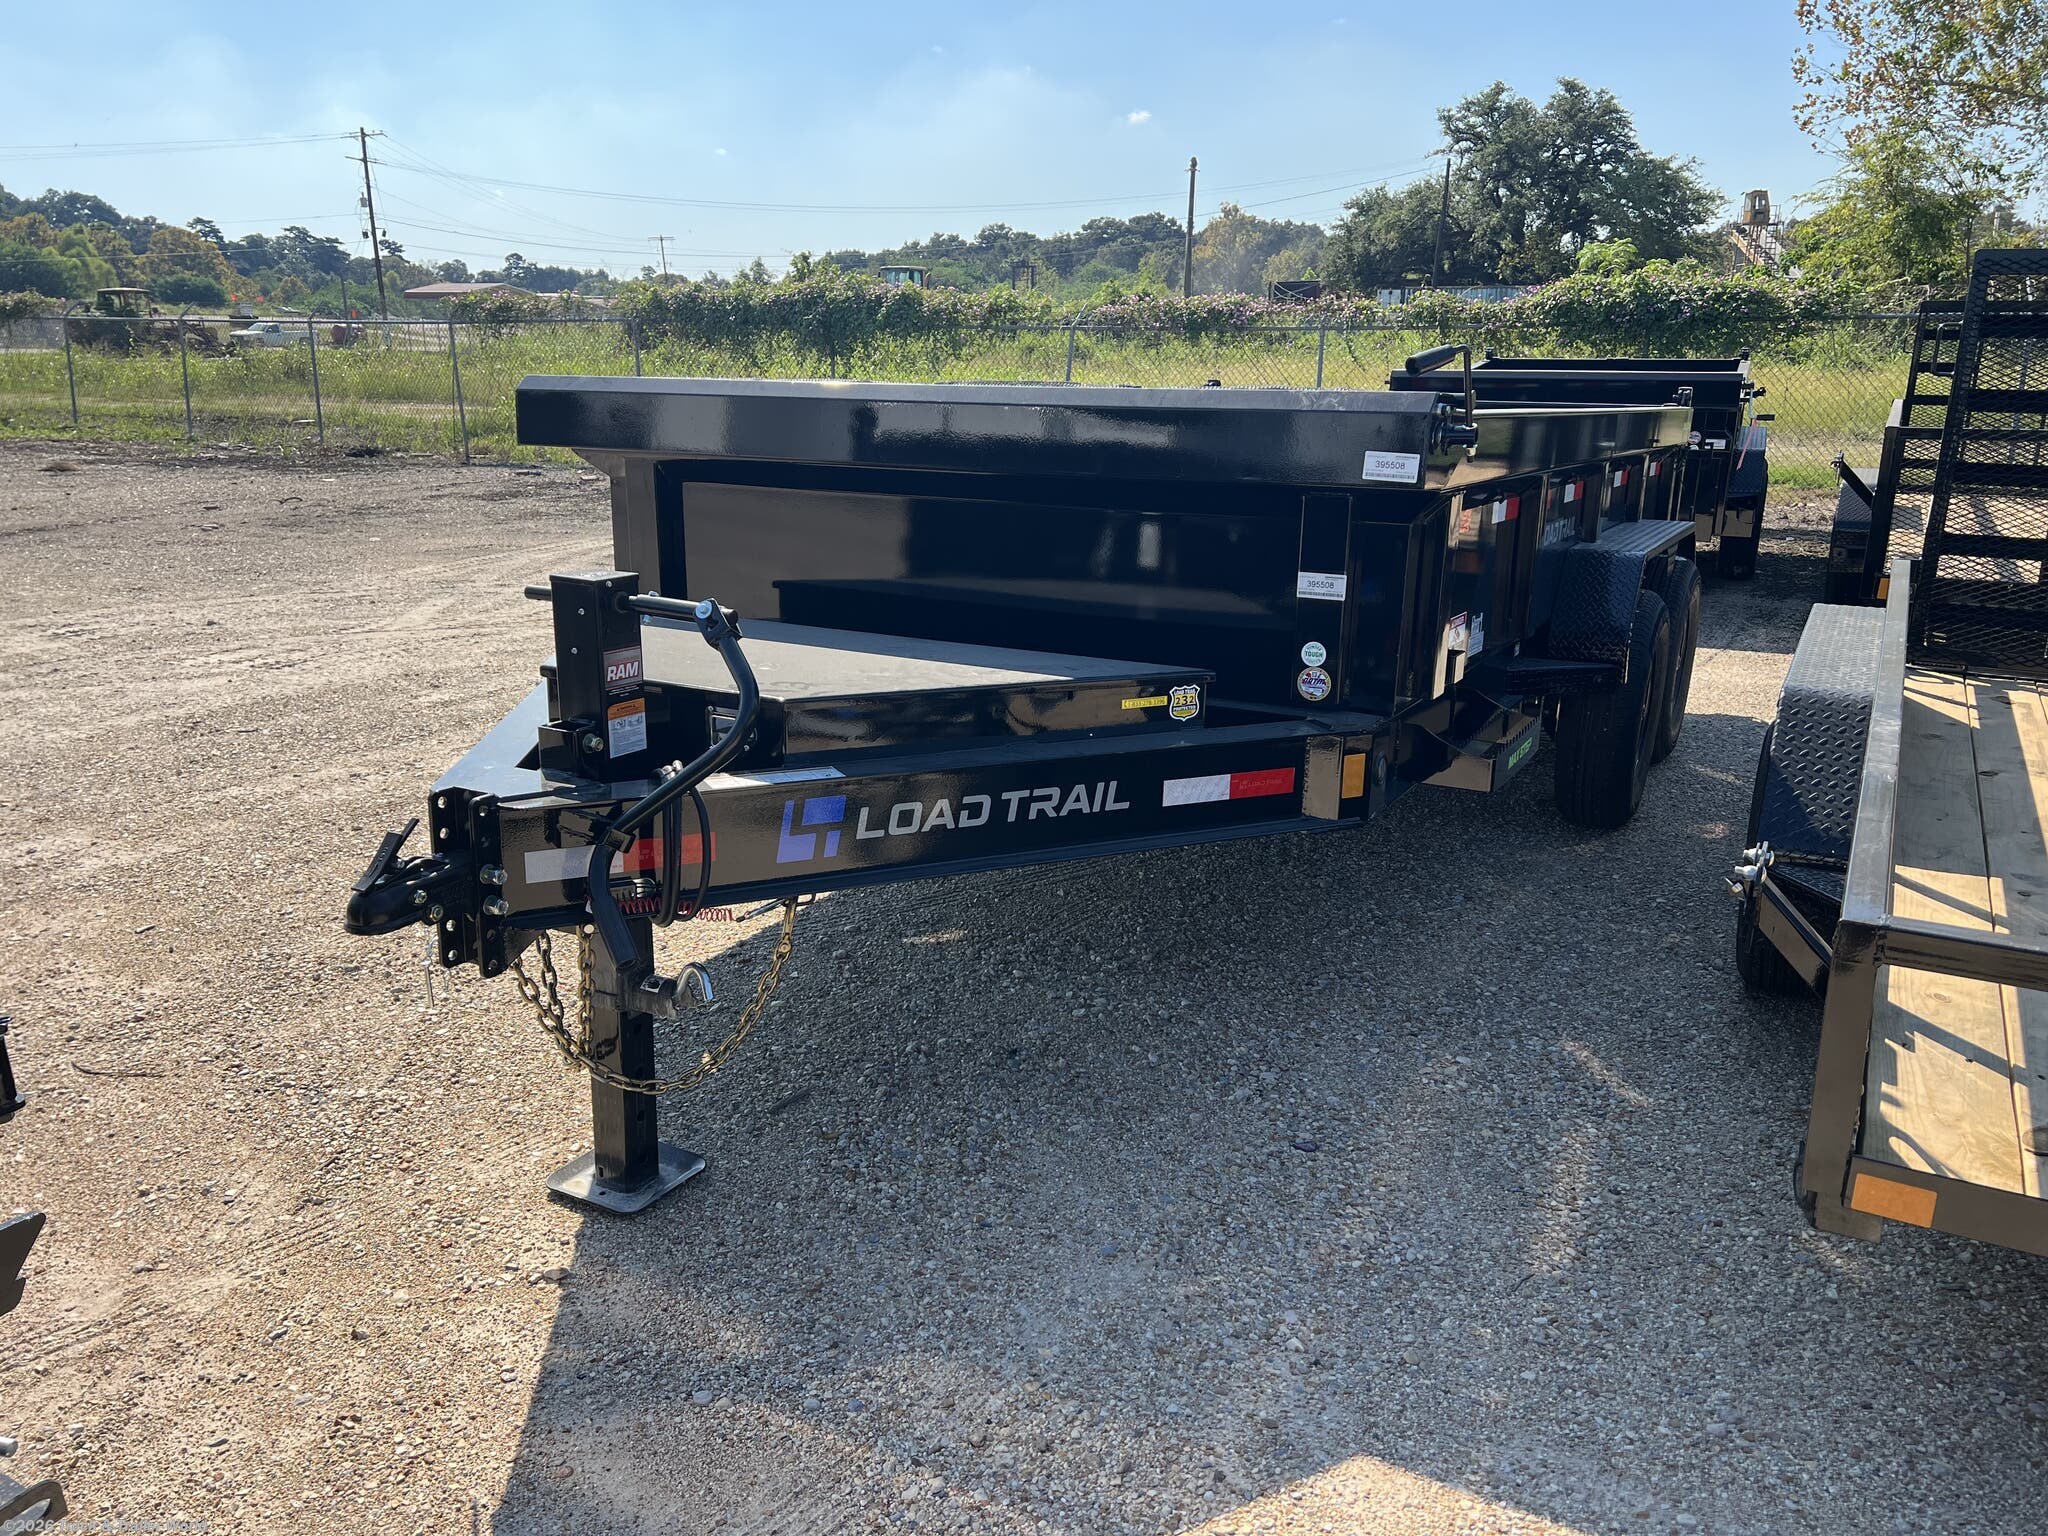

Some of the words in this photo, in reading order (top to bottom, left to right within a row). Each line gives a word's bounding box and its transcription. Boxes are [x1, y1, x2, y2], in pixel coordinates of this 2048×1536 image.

[1375, 459, 1405, 470] 395508
[1306, 580, 1335, 589] 395508
[607, 661, 639, 682] RAM
[1175, 696, 1194, 705] 232
[856, 795, 992, 840] LOAD
[1001, 780, 1131, 822] TRAIL
